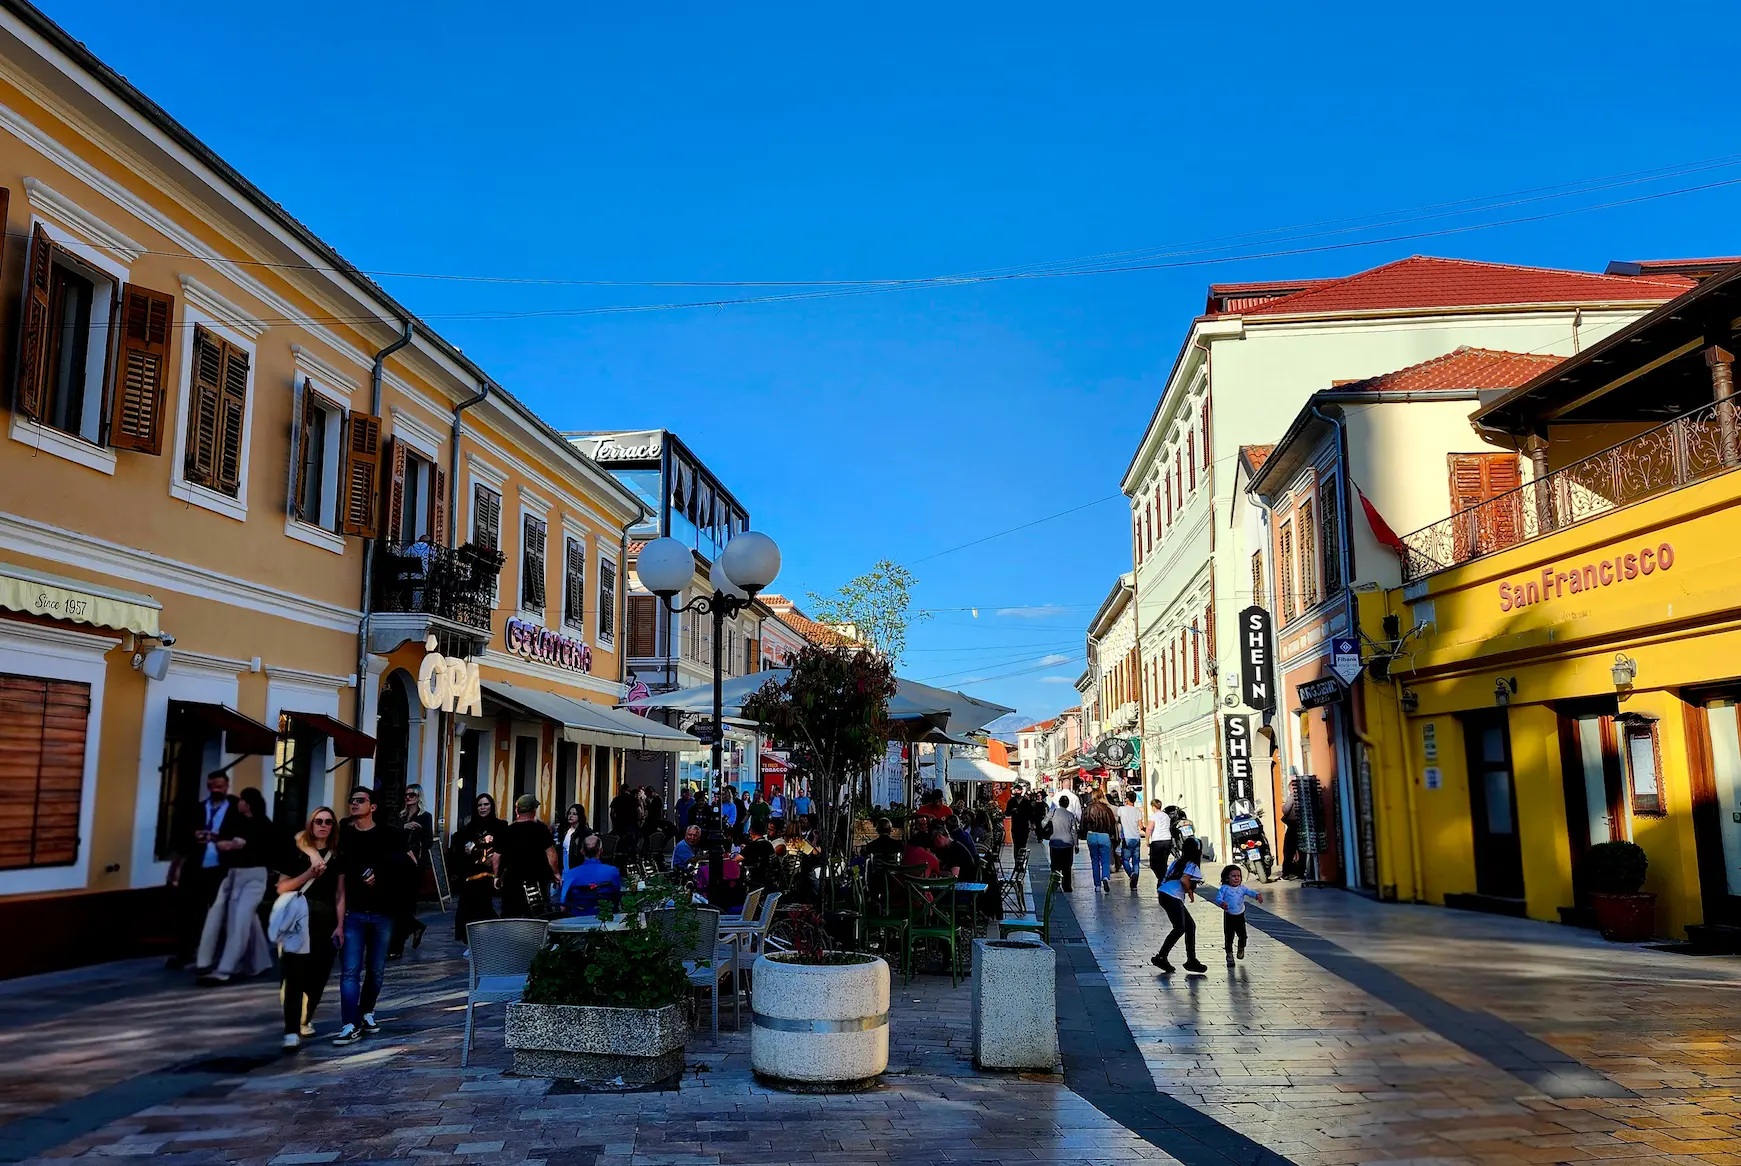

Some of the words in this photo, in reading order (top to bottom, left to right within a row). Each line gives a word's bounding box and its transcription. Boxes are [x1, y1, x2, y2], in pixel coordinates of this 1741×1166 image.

[590, 436, 661, 460] Terrace
[35, 593, 60, 609] Since
[65, 599, 87, 615] 1957
[1249, 614, 1267, 699] SHEIN
[1229, 717, 1250, 816] SHEIN
